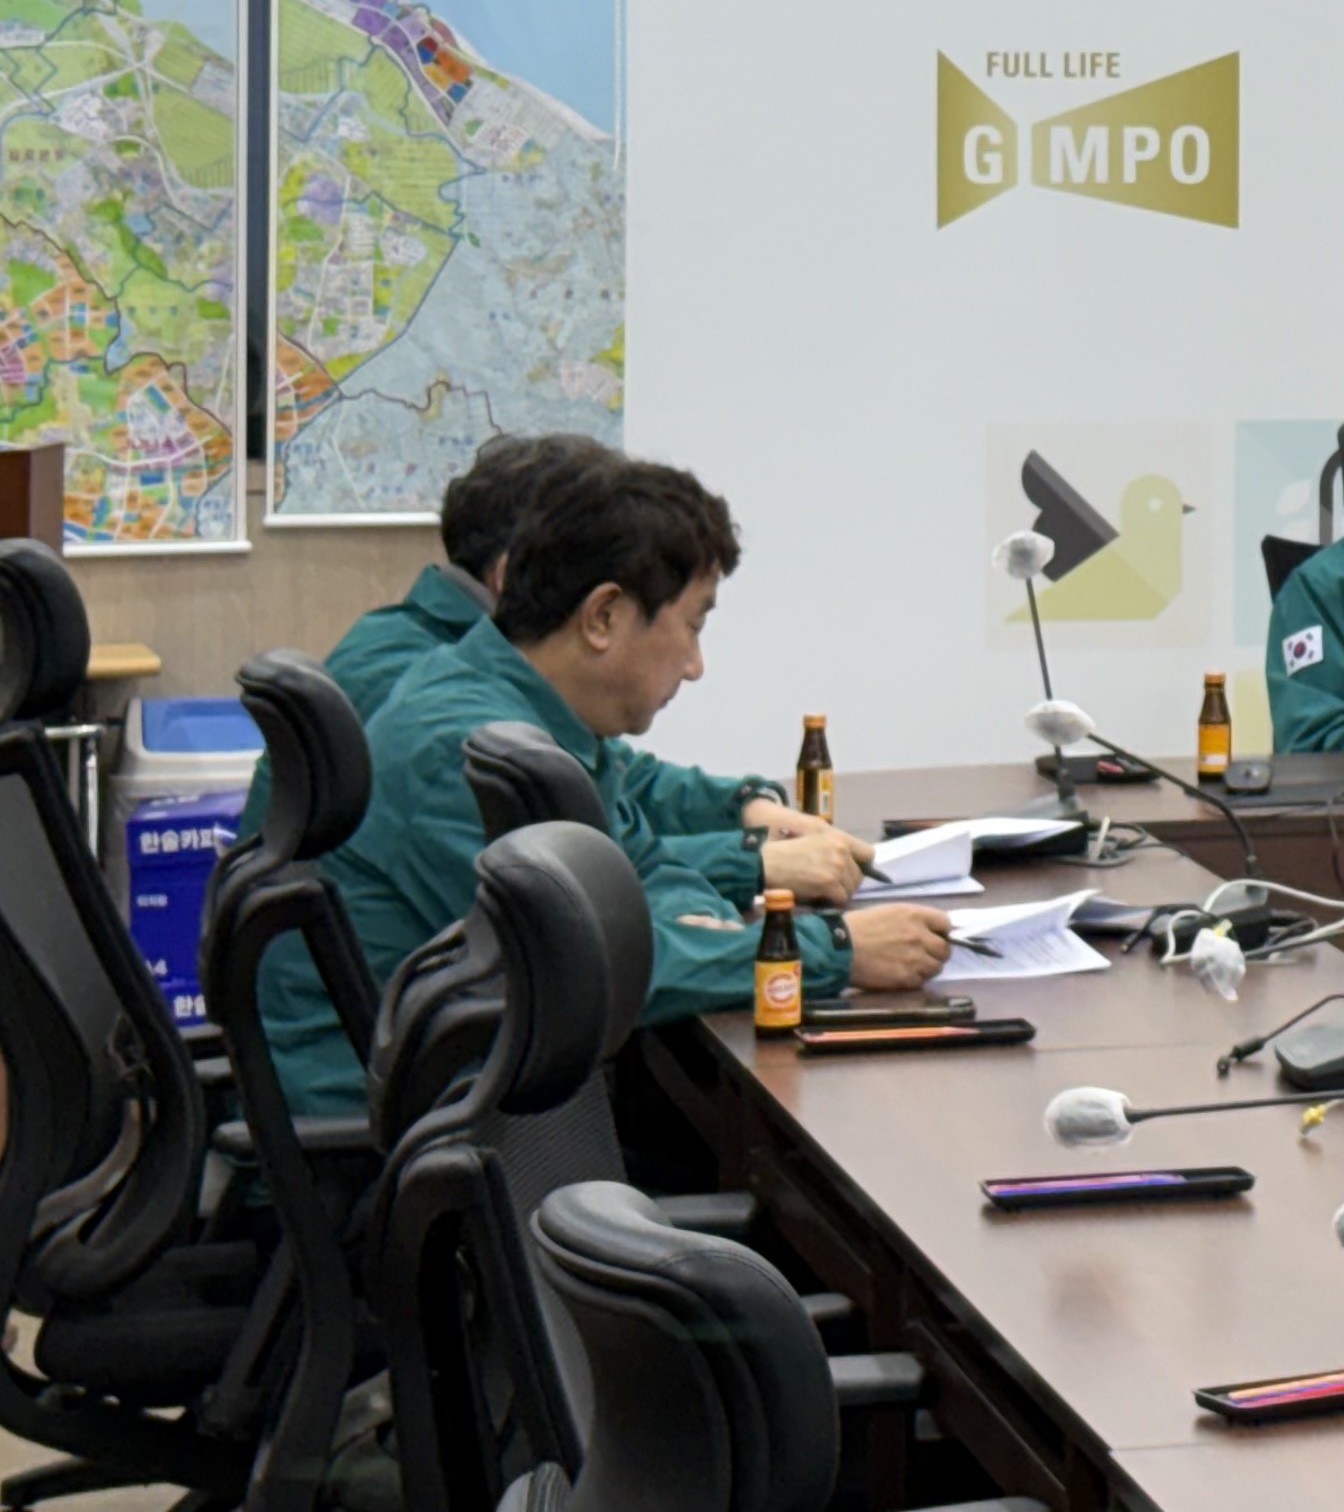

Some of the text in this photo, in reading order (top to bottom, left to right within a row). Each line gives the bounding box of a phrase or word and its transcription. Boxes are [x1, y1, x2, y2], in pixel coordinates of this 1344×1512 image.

[985, 51, 1121, 79] FULL LIFE
[962, 123, 1211, 185] GIMPO
